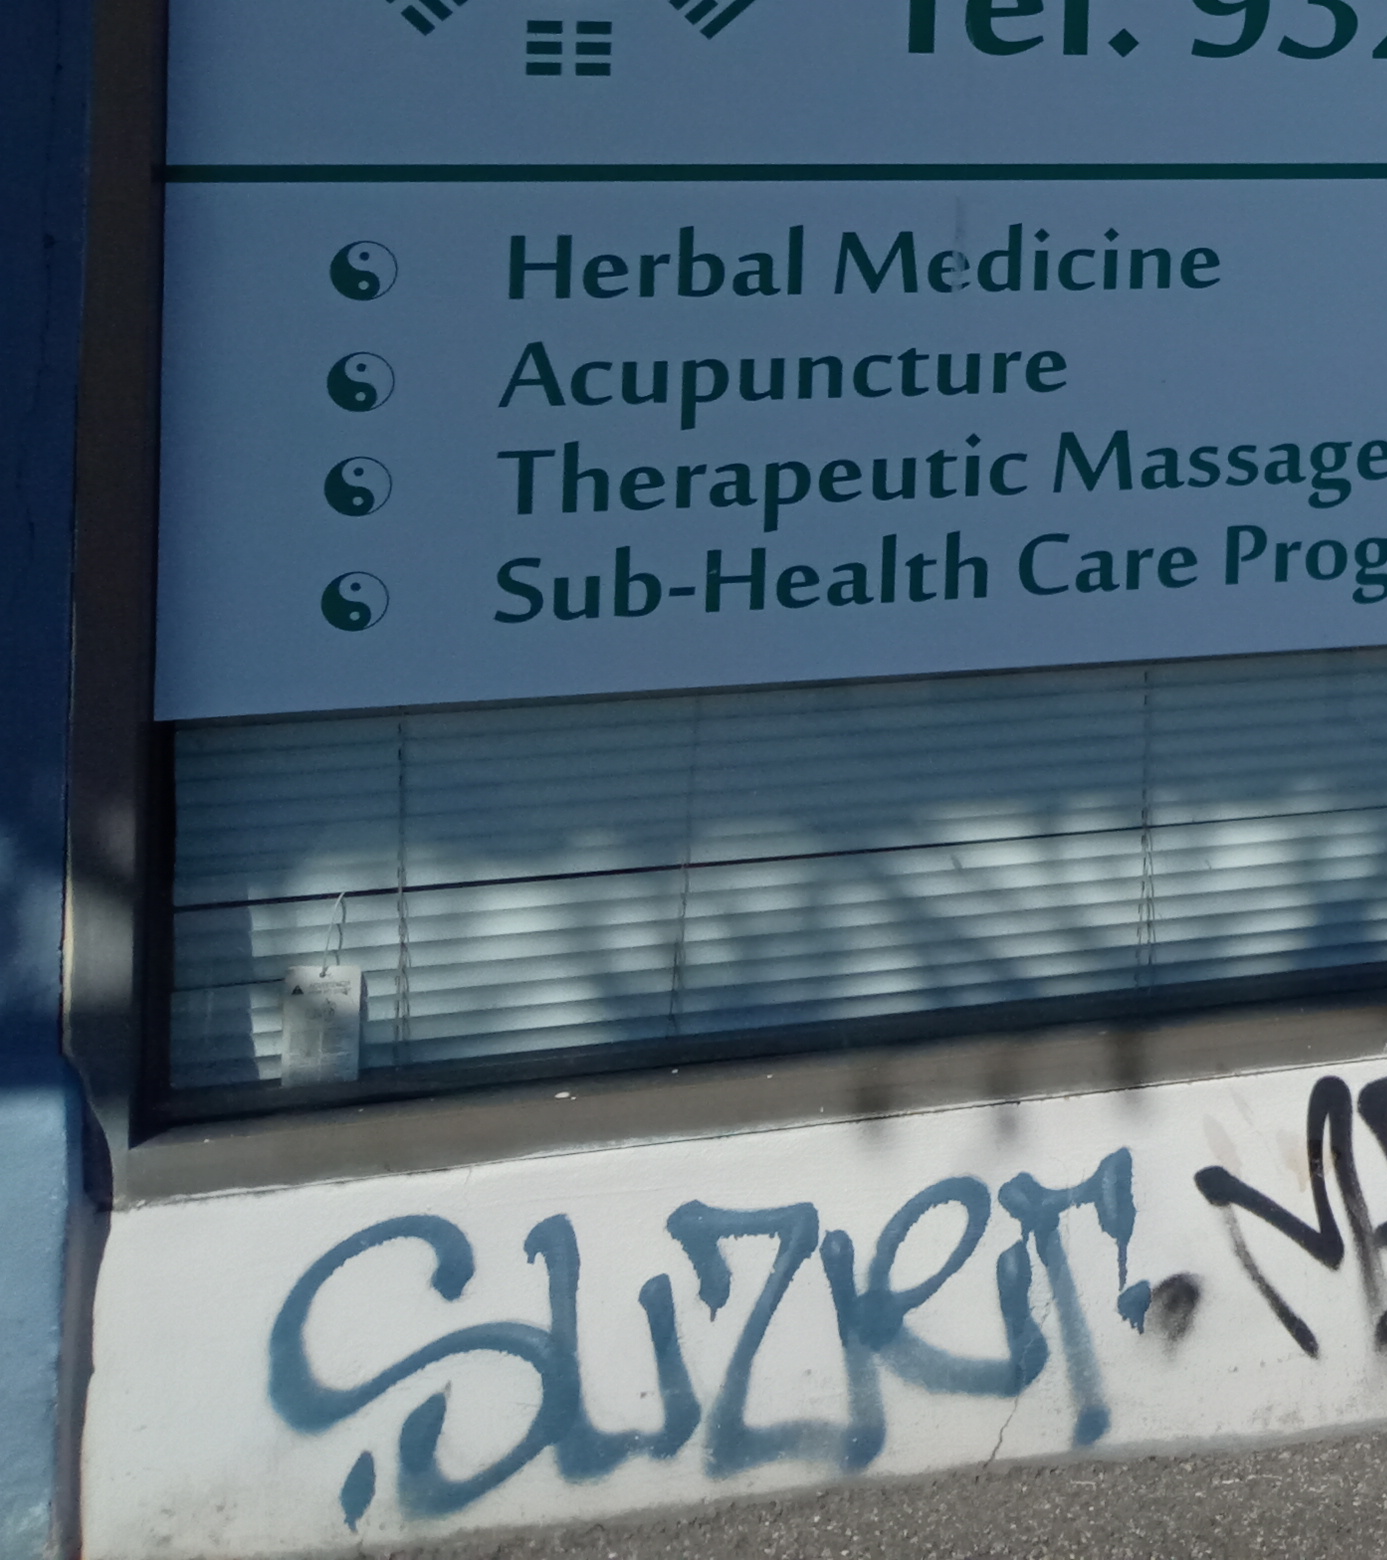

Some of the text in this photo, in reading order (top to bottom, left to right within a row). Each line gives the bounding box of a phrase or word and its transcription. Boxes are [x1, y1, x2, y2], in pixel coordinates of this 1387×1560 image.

[508, 223, 1222, 300] Herbal Medicine
[498, 340, 1068, 431] Acupuncture
[497, 433, 1028, 533] Therapeutic
[493, 531, 989, 624] Sub-Health
[1018, 532, 1199, 596] Care
